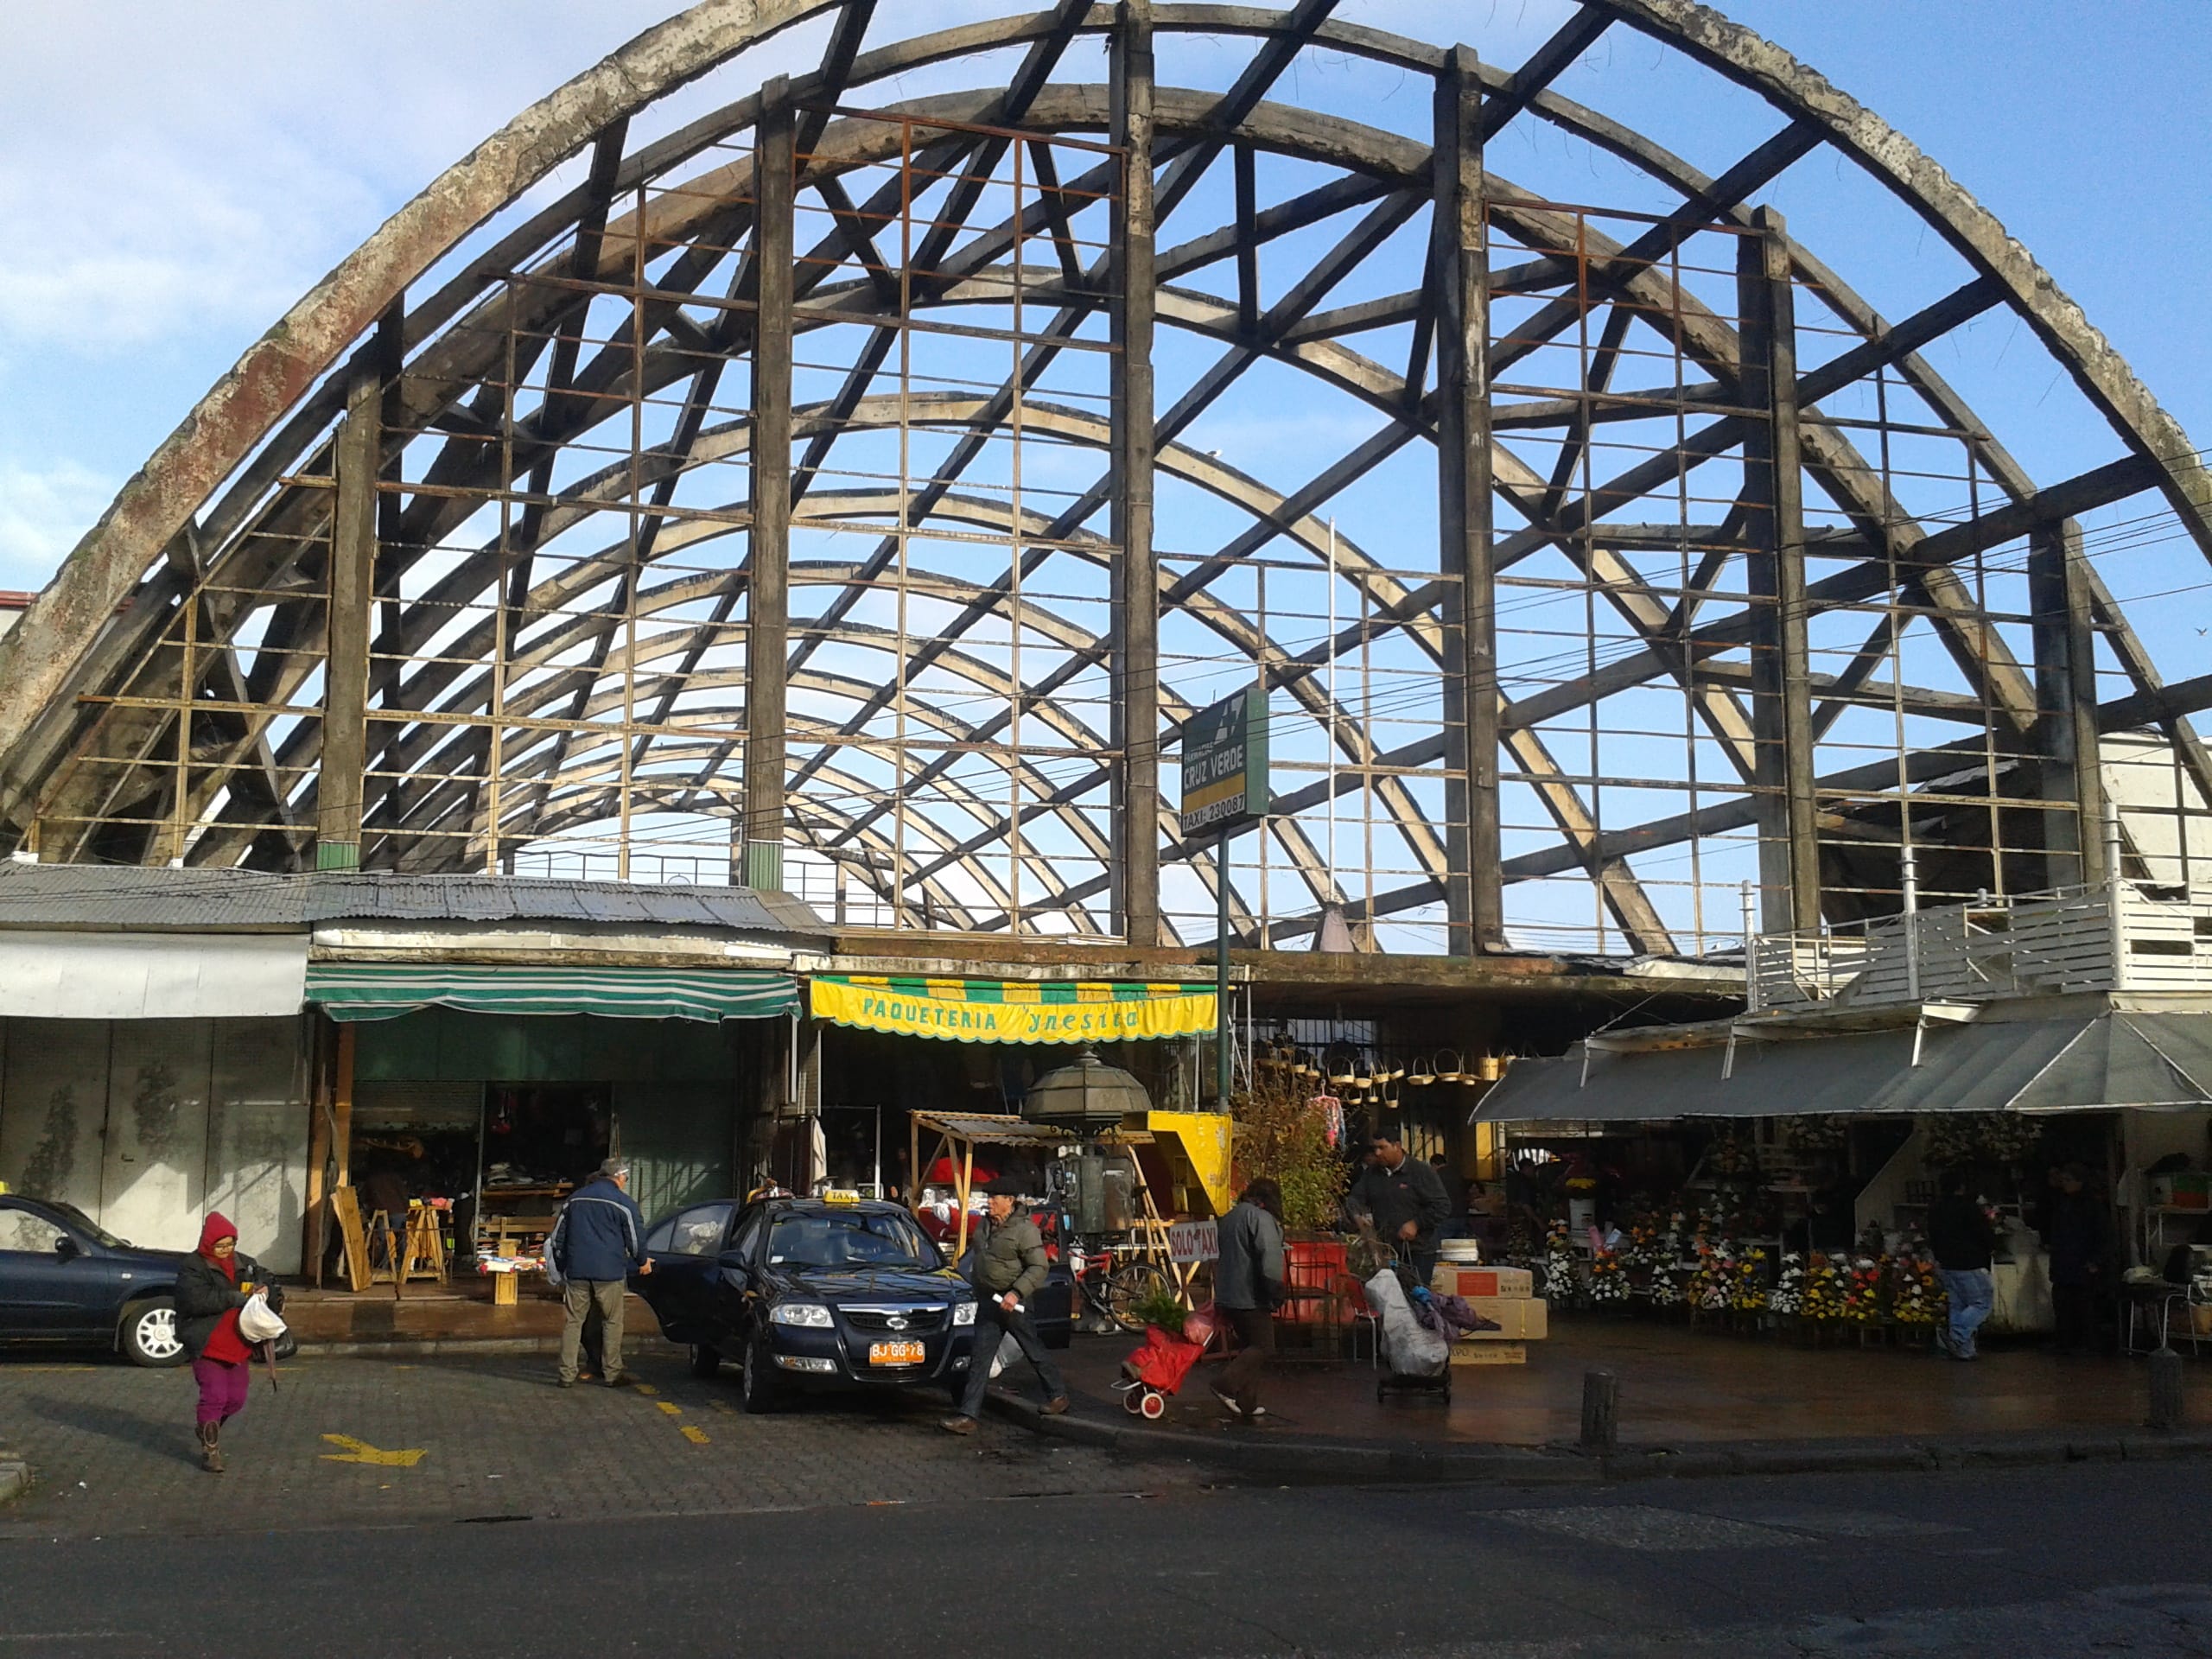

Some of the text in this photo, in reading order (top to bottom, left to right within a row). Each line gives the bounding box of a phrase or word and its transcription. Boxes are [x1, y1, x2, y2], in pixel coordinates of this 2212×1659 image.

[1184, 744, 1243, 791] CRUZ VERDE
[1184, 795, 1244, 830] TAXI: 230087
[864, 998, 996, 1030] PAQUETERIA
[1171, 1229, 1193, 1257] SOLO
